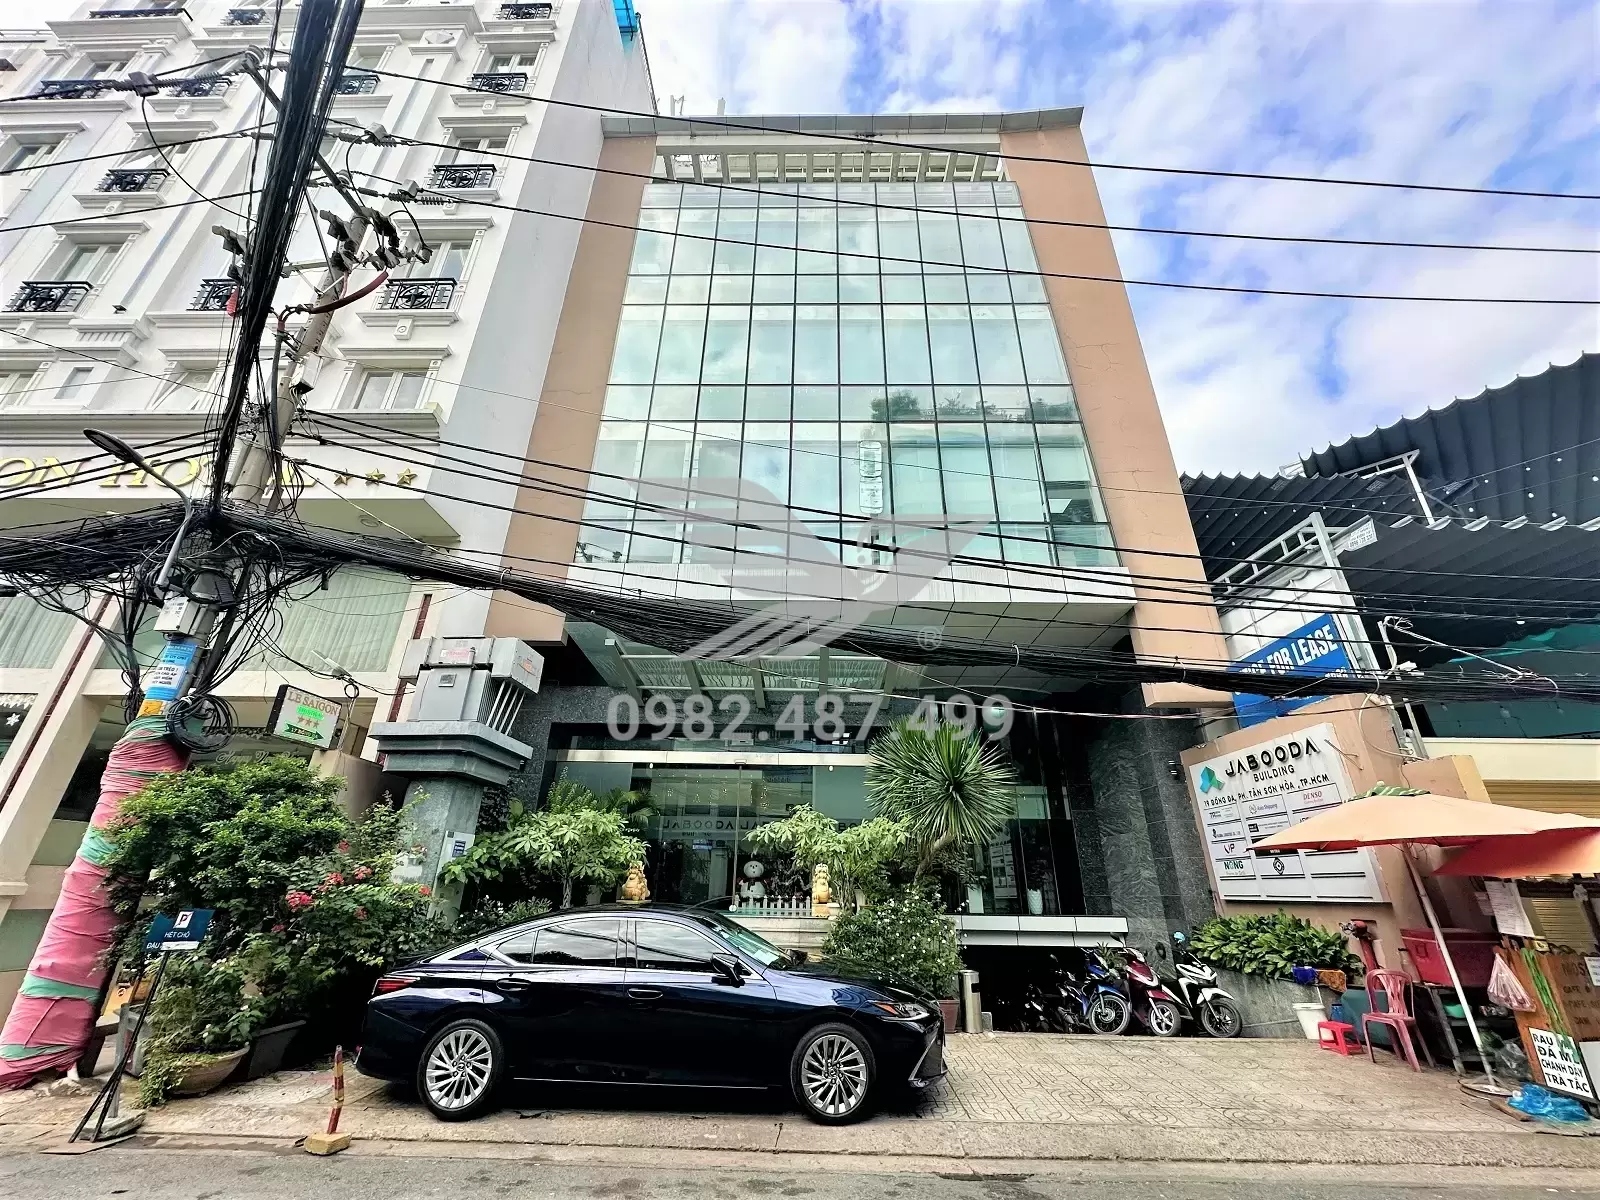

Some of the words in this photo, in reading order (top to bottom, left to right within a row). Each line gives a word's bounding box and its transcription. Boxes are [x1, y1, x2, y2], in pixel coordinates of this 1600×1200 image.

[1266, 649, 1294, 676] FOR
[1291, 624, 1339, 666] LEASE
[288, 690, 301, 703] LE
[304, 696, 339, 716] SAIGON
[1225, 736, 1319, 777] JABOODA
[1253, 764, 1296, 782] BUILDING
[1248, 788, 1262, 798] TÂN
[1263, 785, 1278, 795] SƠN
[1279, 780, 1295, 791] HÒA
[1303, 790, 1323, 801] DENSO
[1532, 1033, 1554, 1046] RAU
[1541, 1058, 1567, 1073] CHANH
